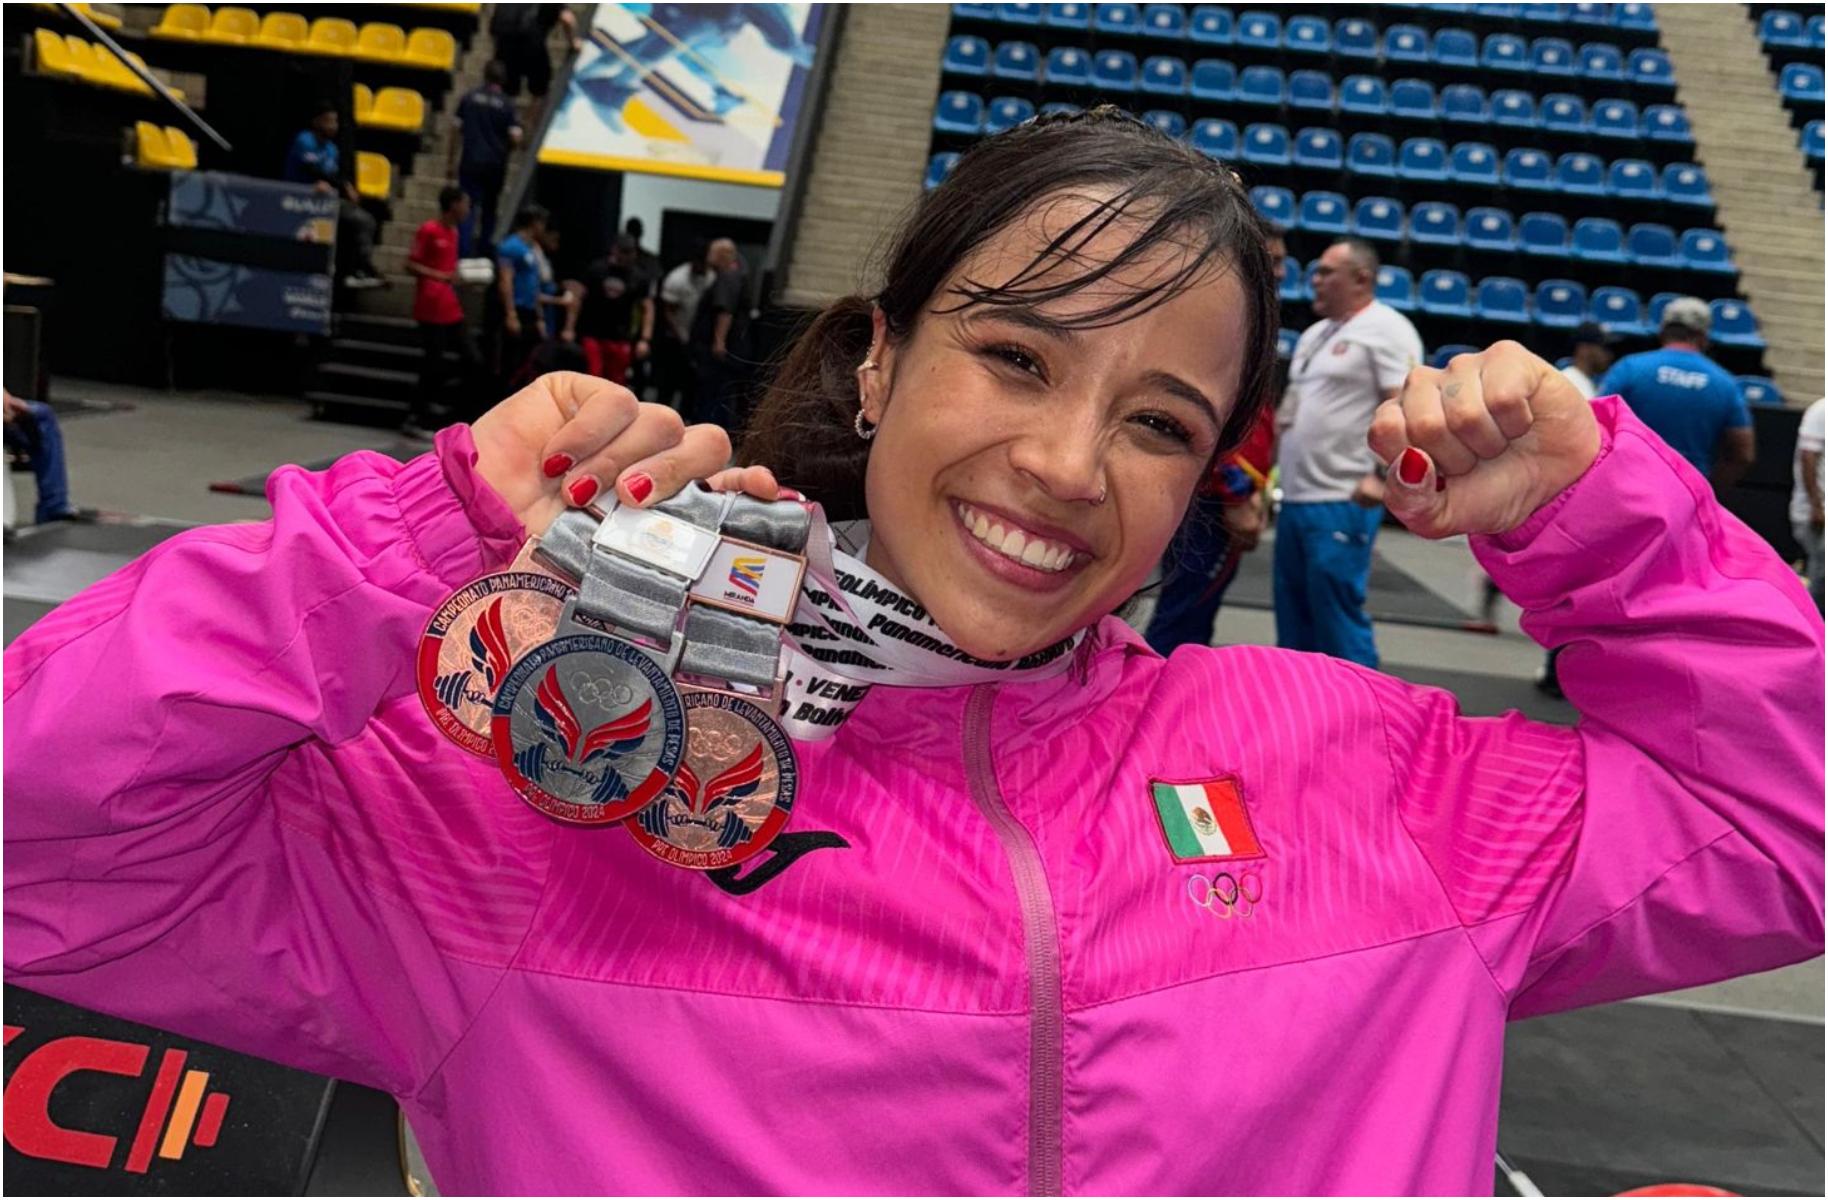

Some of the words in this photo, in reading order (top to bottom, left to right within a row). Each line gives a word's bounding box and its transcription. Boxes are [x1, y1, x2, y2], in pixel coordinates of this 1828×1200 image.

[1657, 366, 1709, 389] STAFF
[433, 581, 488, 632] CAMPEONATO
[489, 575, 565, 599] PANAMERICANO
[615, 642, 627, 657] DE
[626, 649, 679, 717] LEVANTAMIENTO
[662, 733, 681, 766] PESAS
[651, 840, 669, 855] PRE
[710, 850, 733, 865] 2024
